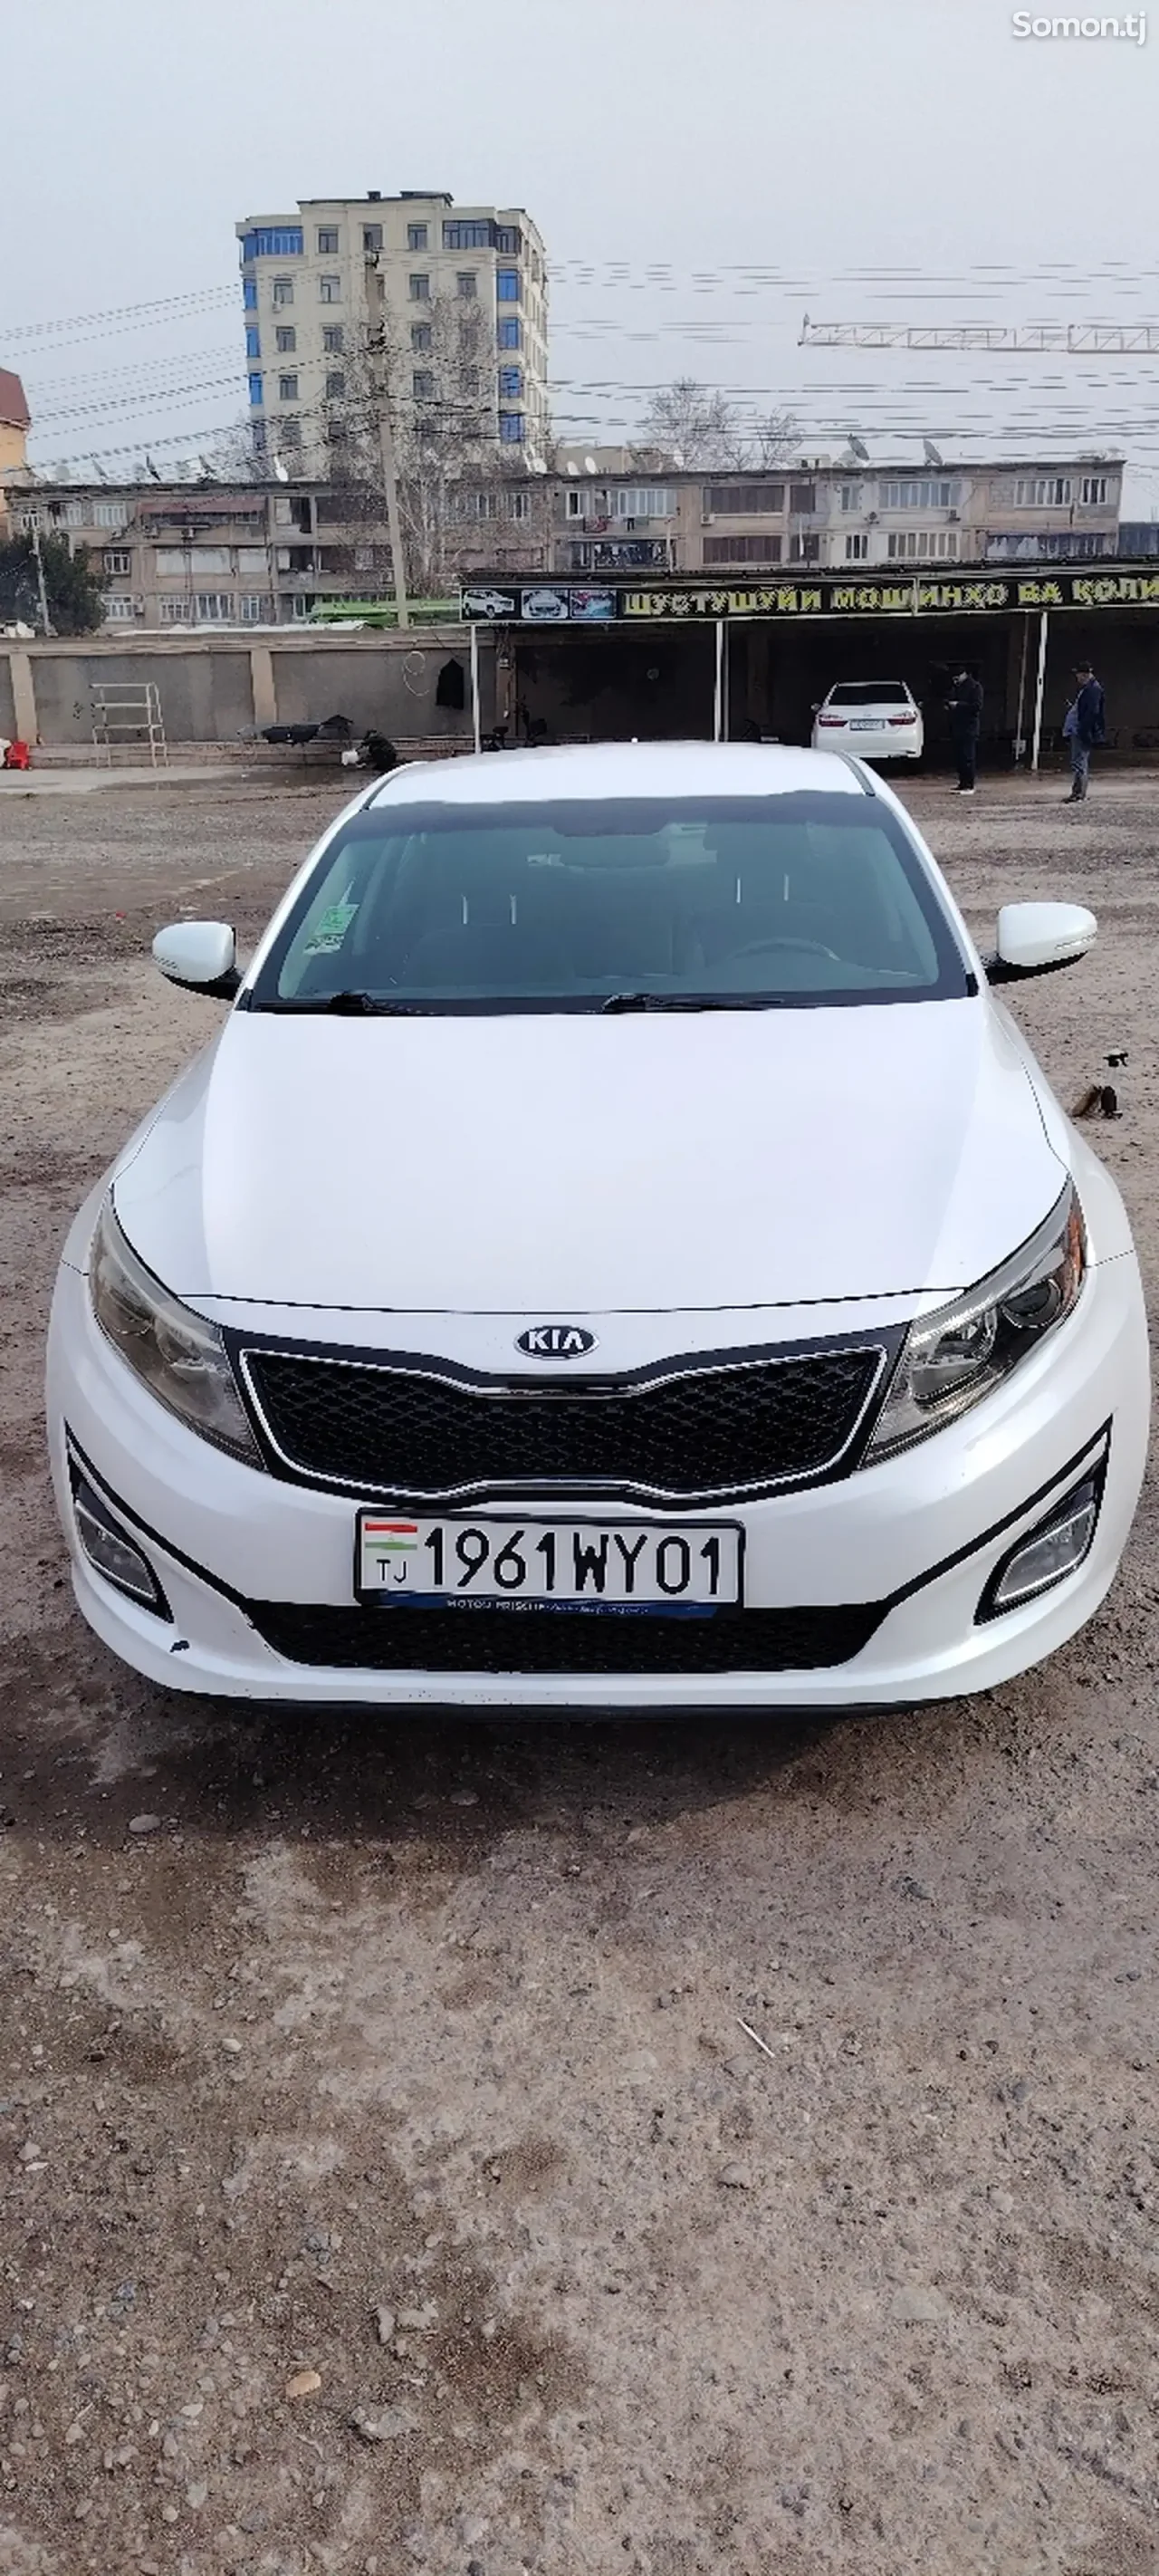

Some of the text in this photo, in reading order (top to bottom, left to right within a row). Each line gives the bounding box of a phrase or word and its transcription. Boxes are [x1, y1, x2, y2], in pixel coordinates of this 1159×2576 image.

[1018, 581, 1063, 605] ВА
[529, 1329, 584, 1350] KIA
[377, 1559, 407, 1583] TJ
[425, 1527, 720, 1595] 1961WY01
